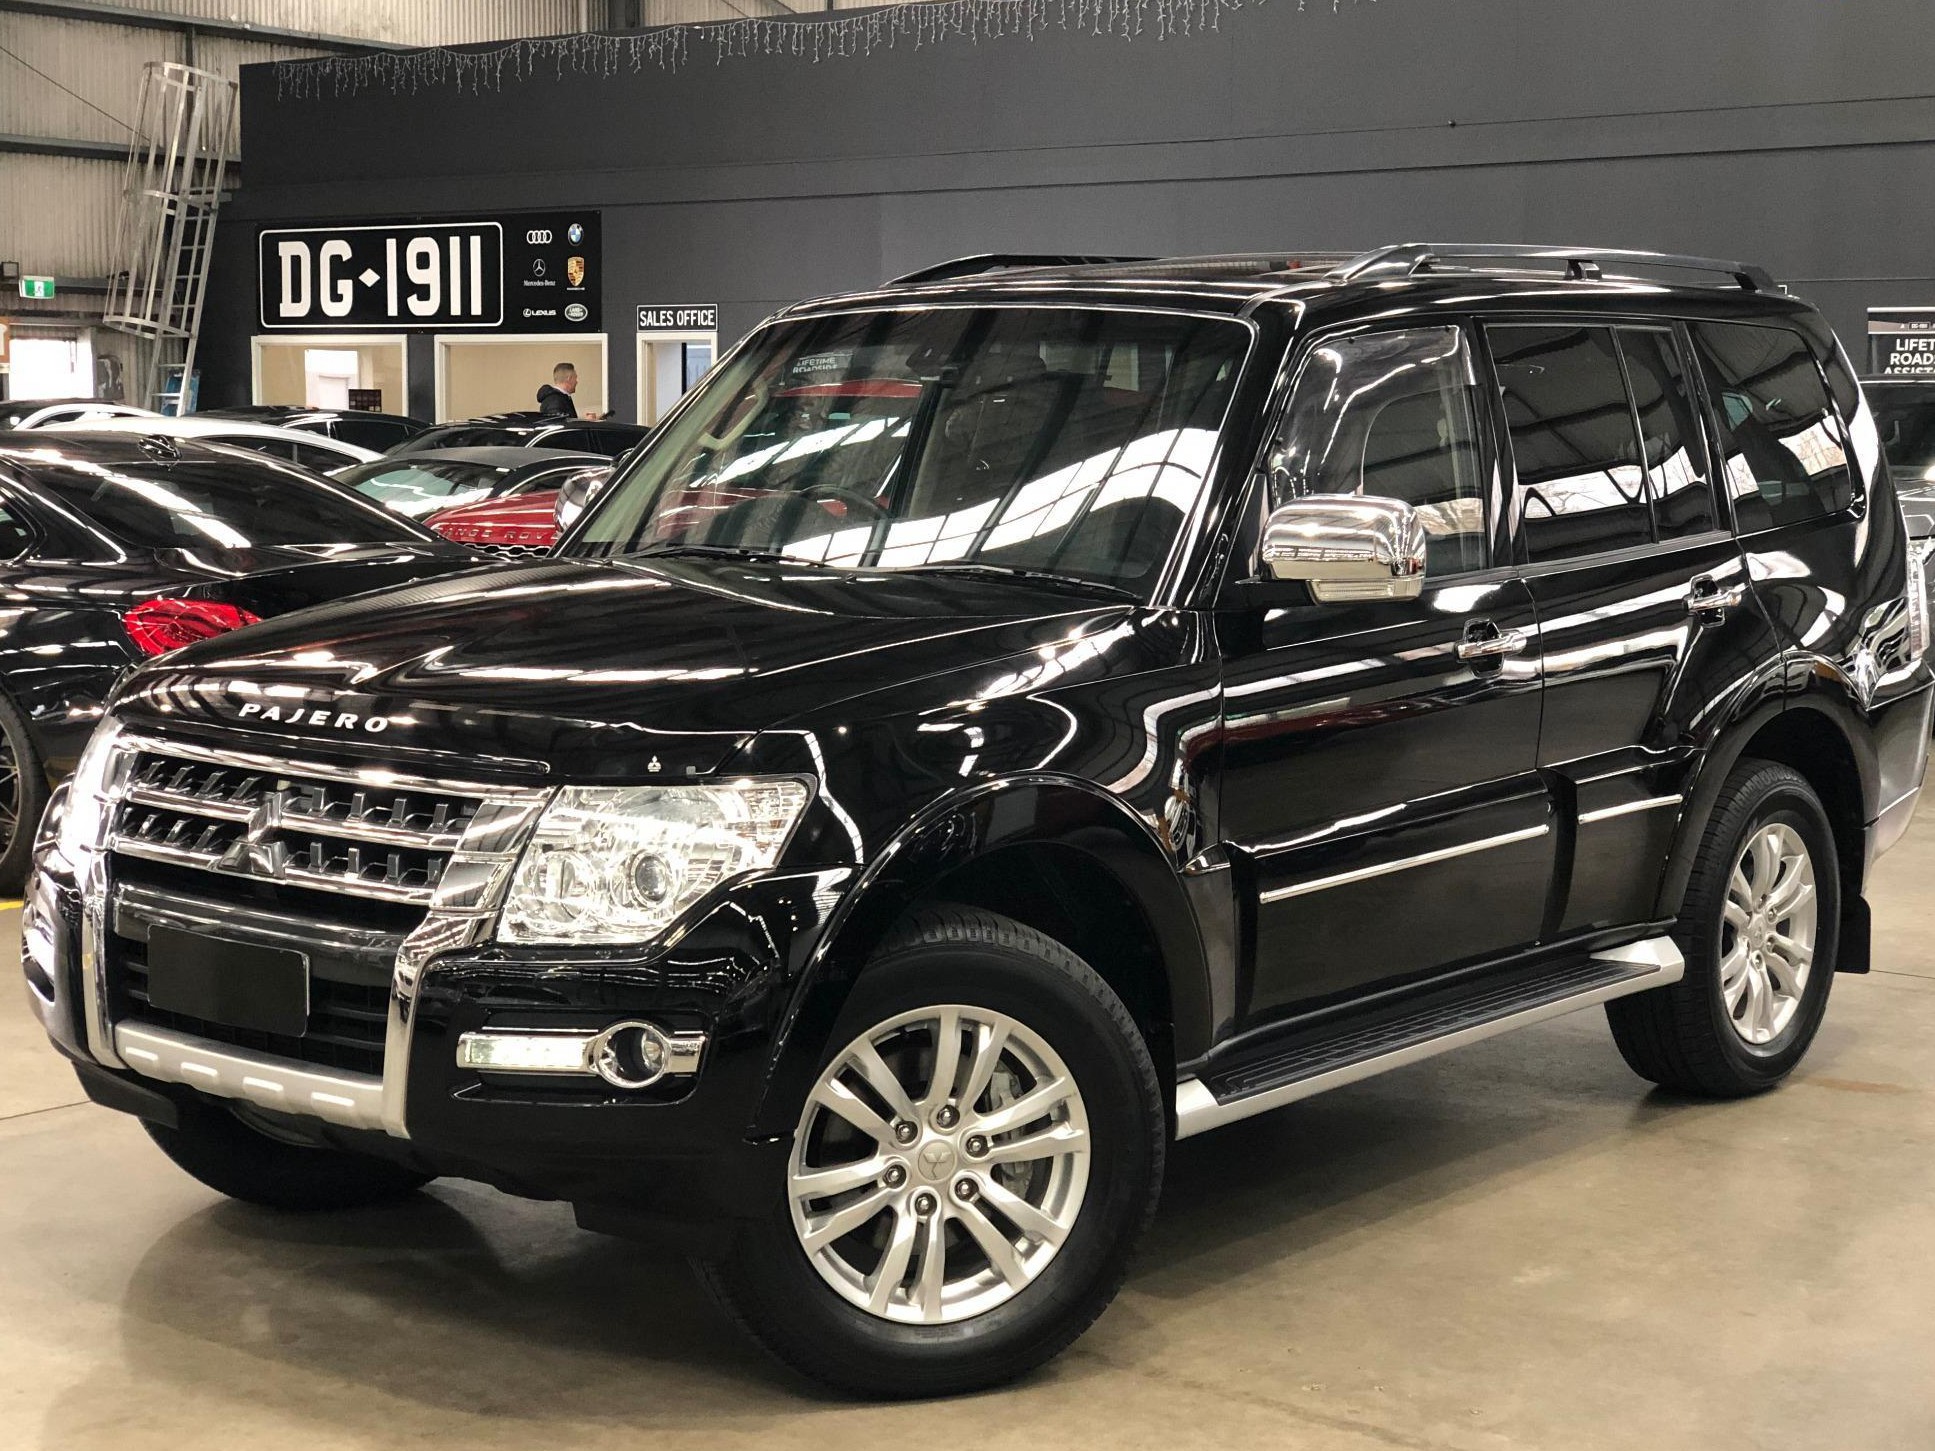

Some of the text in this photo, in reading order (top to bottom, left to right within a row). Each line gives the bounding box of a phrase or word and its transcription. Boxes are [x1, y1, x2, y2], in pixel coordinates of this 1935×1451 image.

[640, 309, 715, 327] SALES OFFICE
[1889, 352, 1935, 366] ROAD
[238, 703, 388, 732] PAJERO
